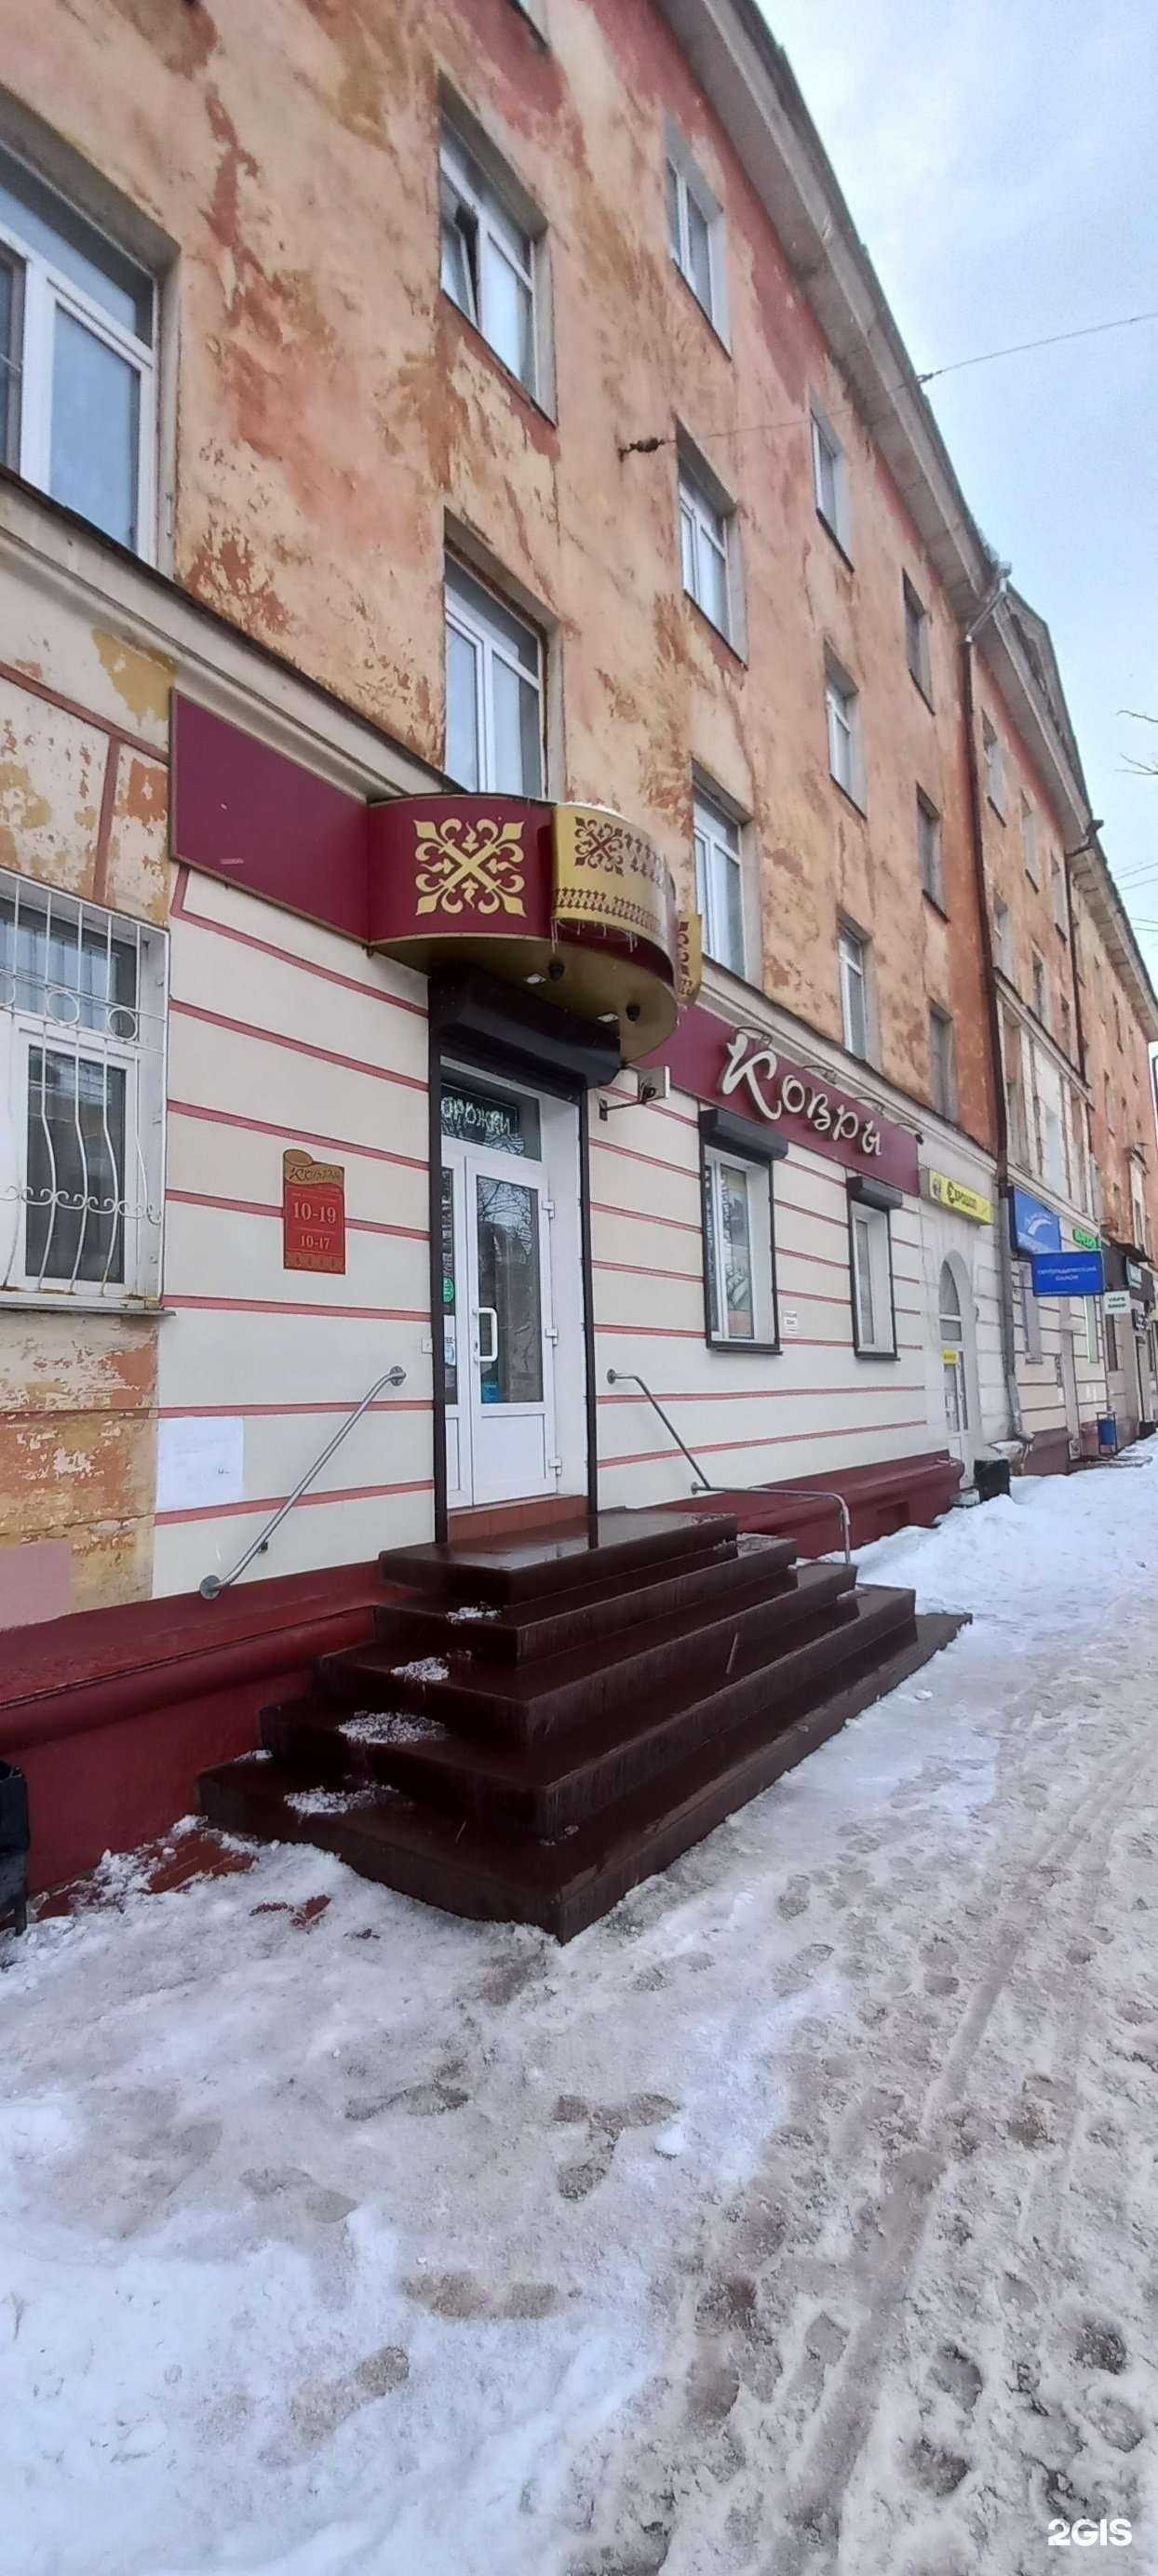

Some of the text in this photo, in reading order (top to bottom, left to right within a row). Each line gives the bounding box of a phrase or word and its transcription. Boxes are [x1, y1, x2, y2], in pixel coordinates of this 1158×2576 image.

[720, 1033, 882, 1156] Ковры
[293, 1201, 336, 1224] 10-19
[301, 1235, 330, 1250] 10-17
